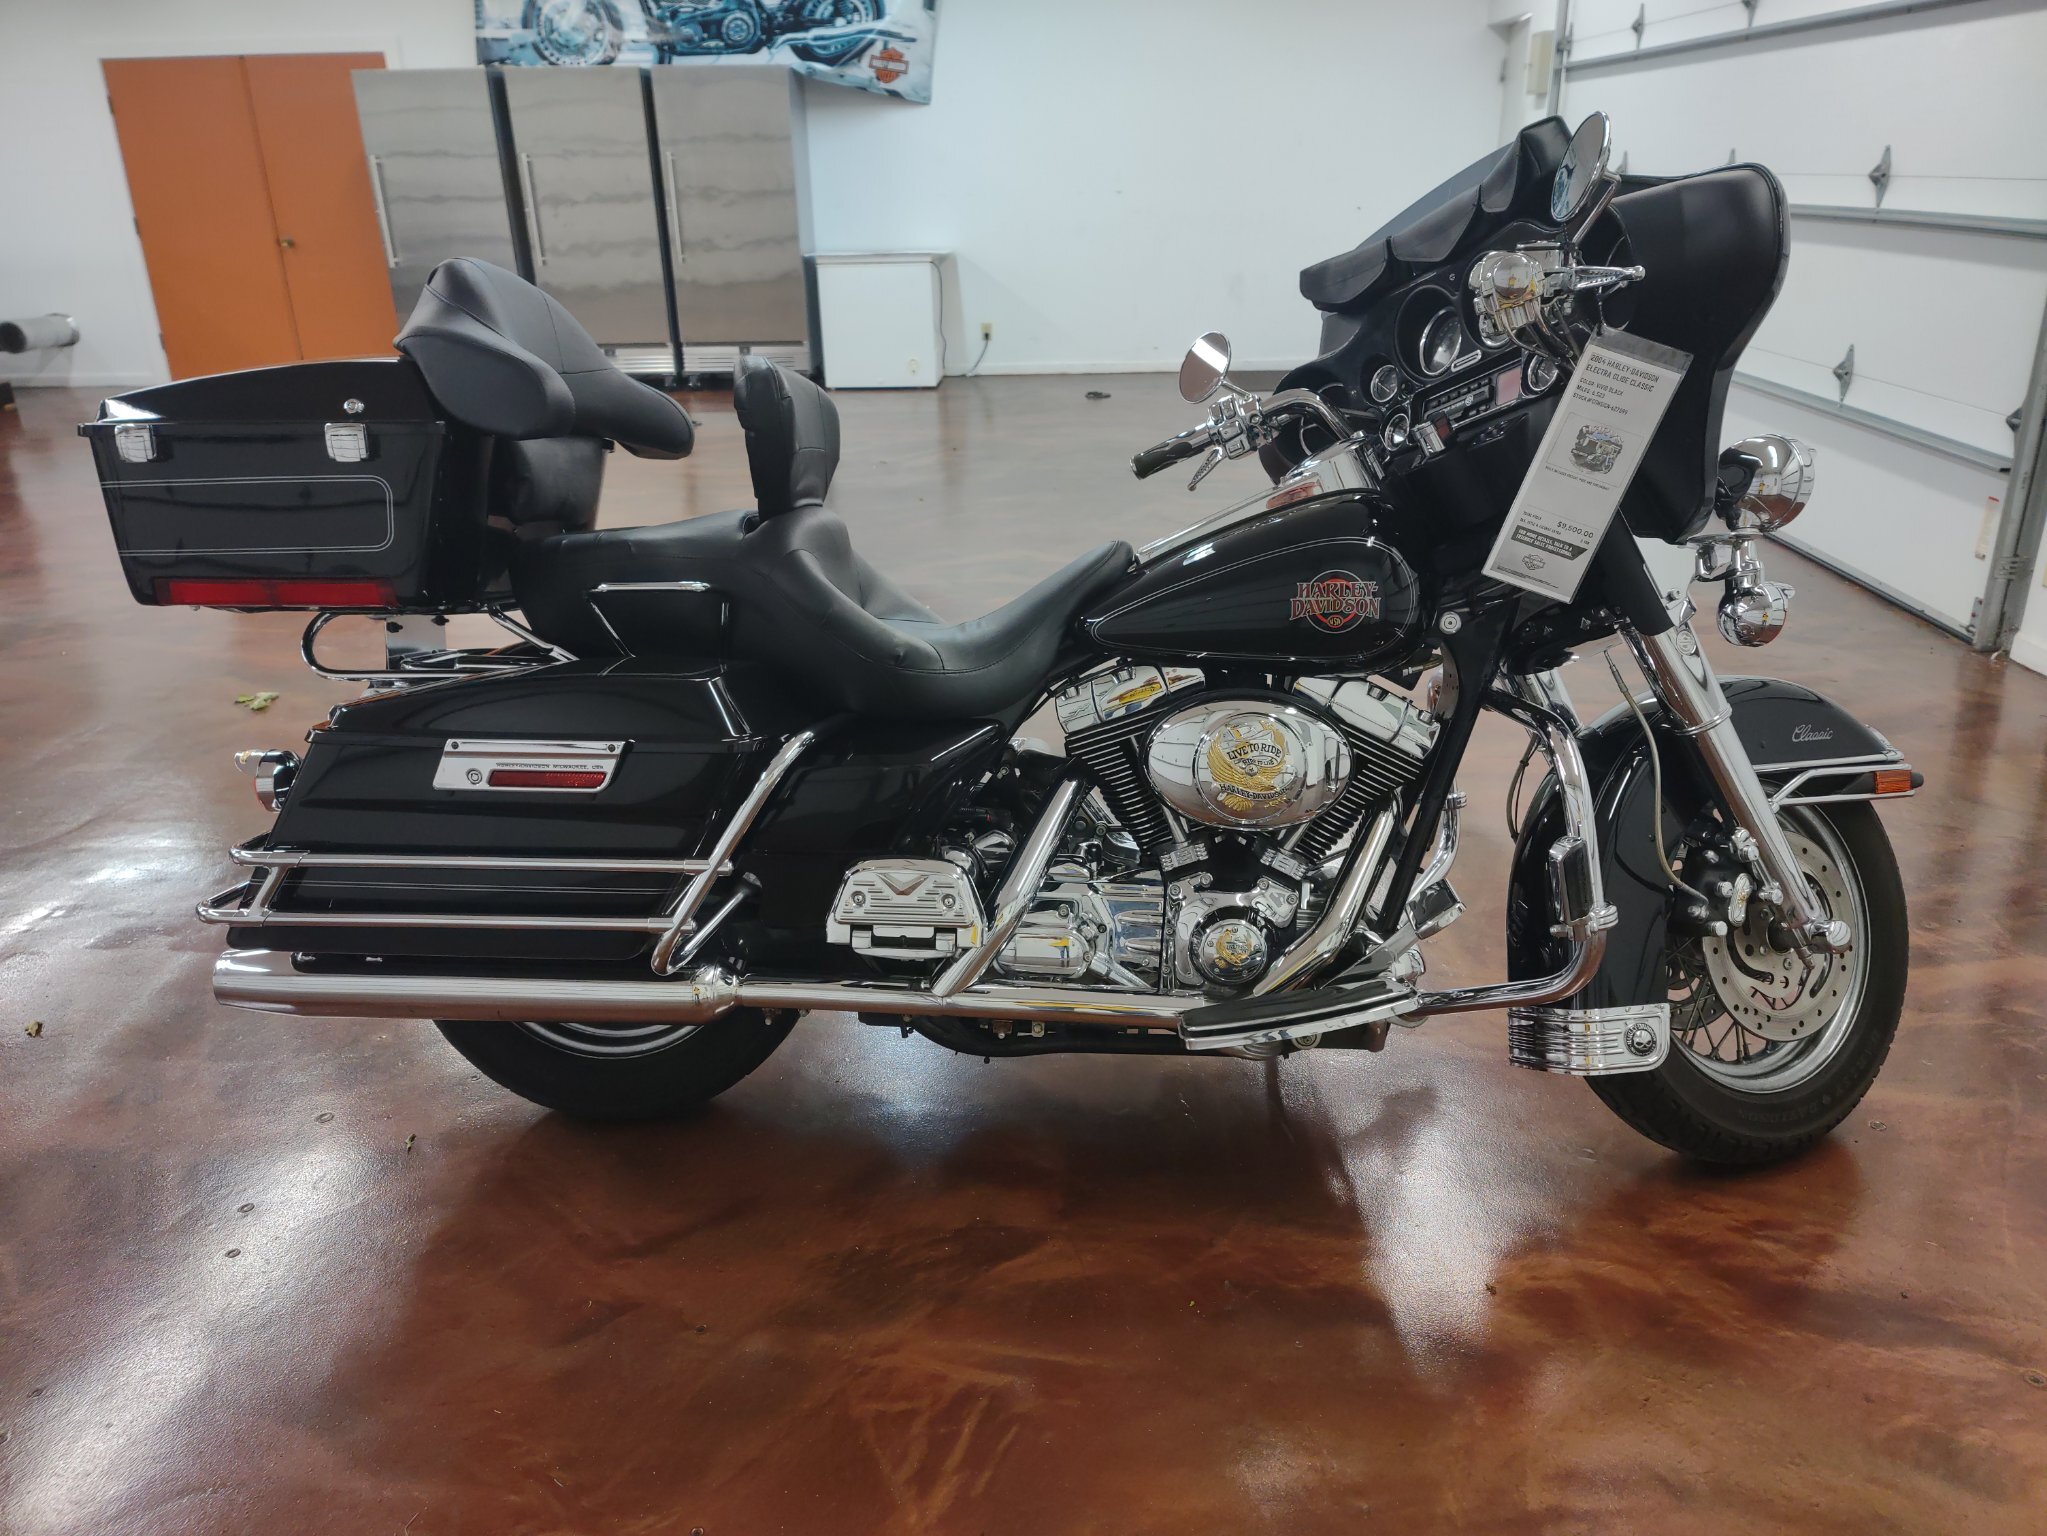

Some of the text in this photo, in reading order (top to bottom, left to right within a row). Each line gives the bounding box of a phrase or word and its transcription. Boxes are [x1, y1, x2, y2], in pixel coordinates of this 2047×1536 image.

[1590, 354, 1660, 383] 2004 HARLEY-DAVIDSON
[1586, 364, 1655, 393] ELECTRA GLIDE CLASSIC
[1596, 382, 1608, 391] VIVID
[1608, 386, 1624, 397] BLACK
[1556, 521, 1594, 538] $9,500.00
[1297, 581, 1378, 599] HARLEY-
[1290, 597, 1382, 620] DAVIDSON
[1329, 616, 1342, 626] USA
[1792, 724, 1834, 742] Classic
[1226, 743, 1282, 760] LIVE TO RIDE
[1219, 784, 1290, 800] HARLEY-DAVIDSON
